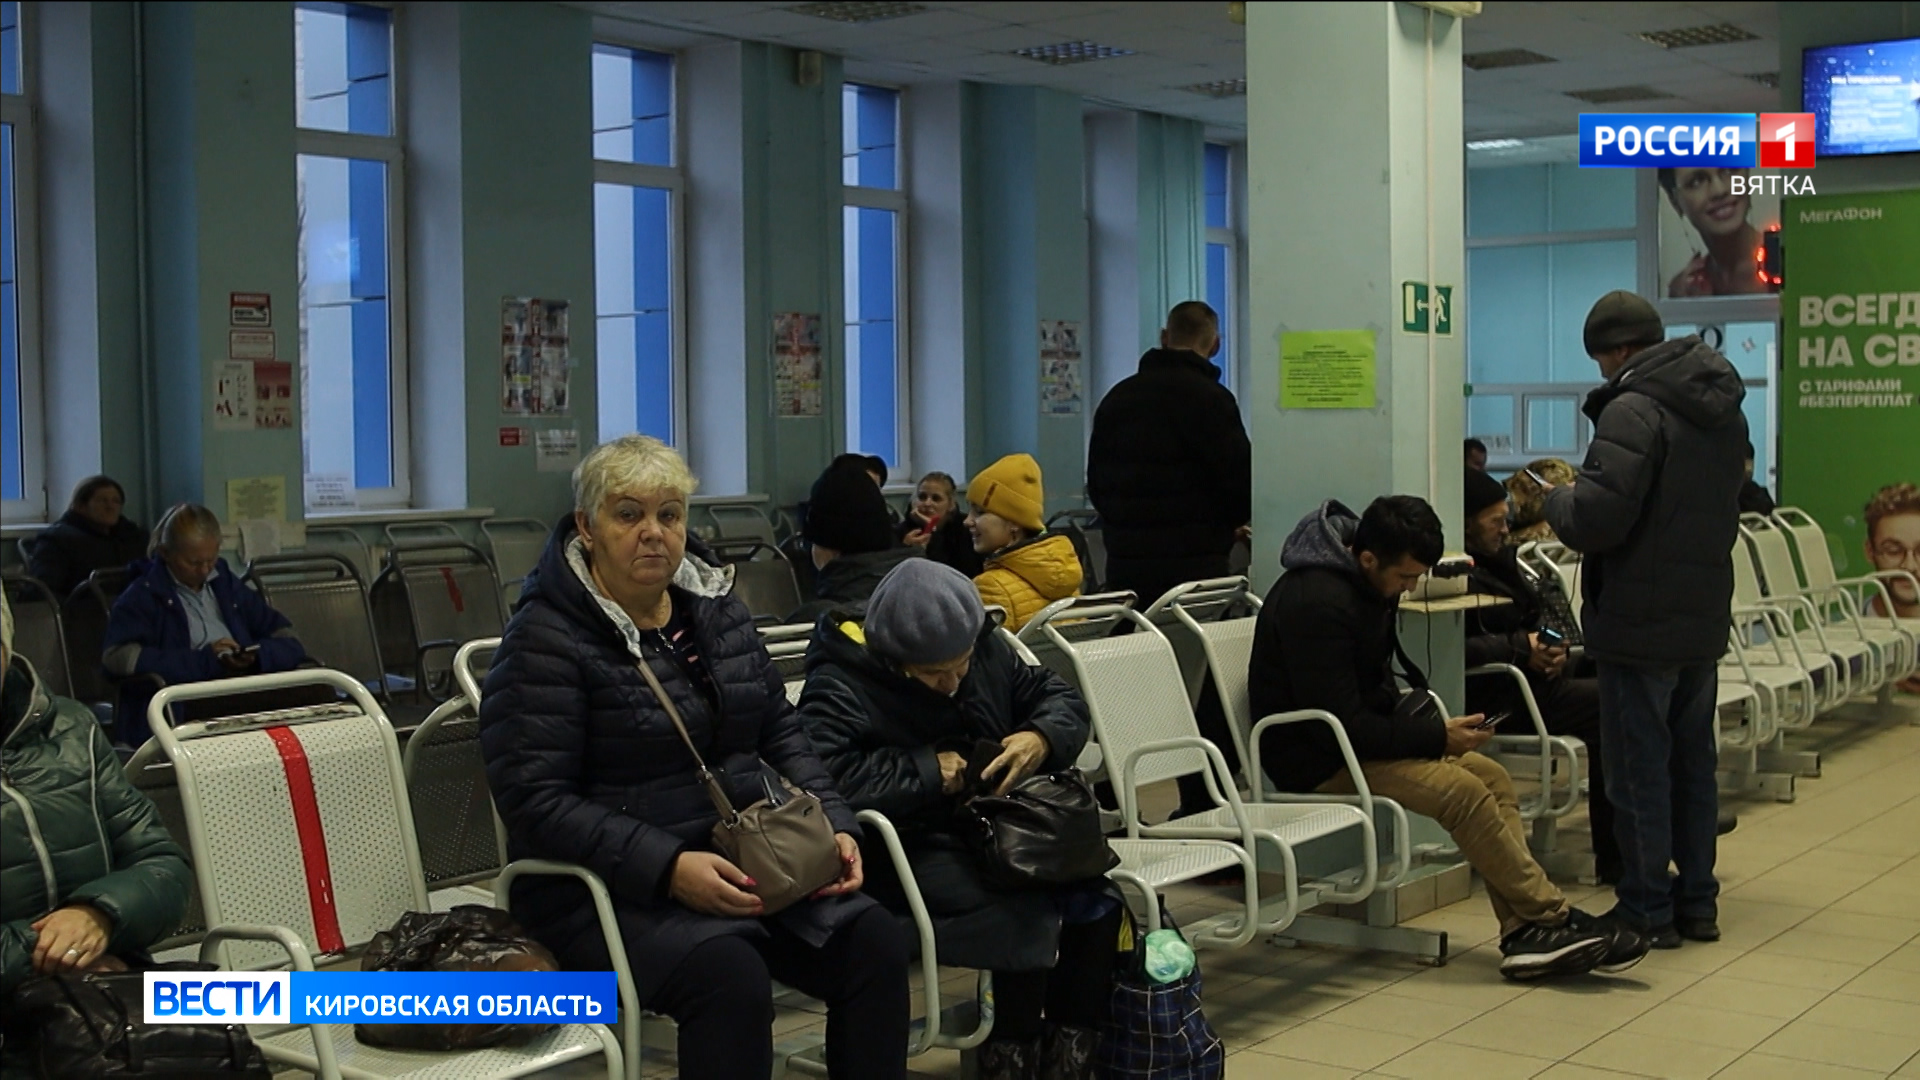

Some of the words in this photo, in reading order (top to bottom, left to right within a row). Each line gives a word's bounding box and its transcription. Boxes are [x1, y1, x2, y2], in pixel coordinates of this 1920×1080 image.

[1799, 335, 1854, 368] НА
[1799, 379, 1812, 393] С
[1815, 378, 1902, 392] ТАРИФАМИ
